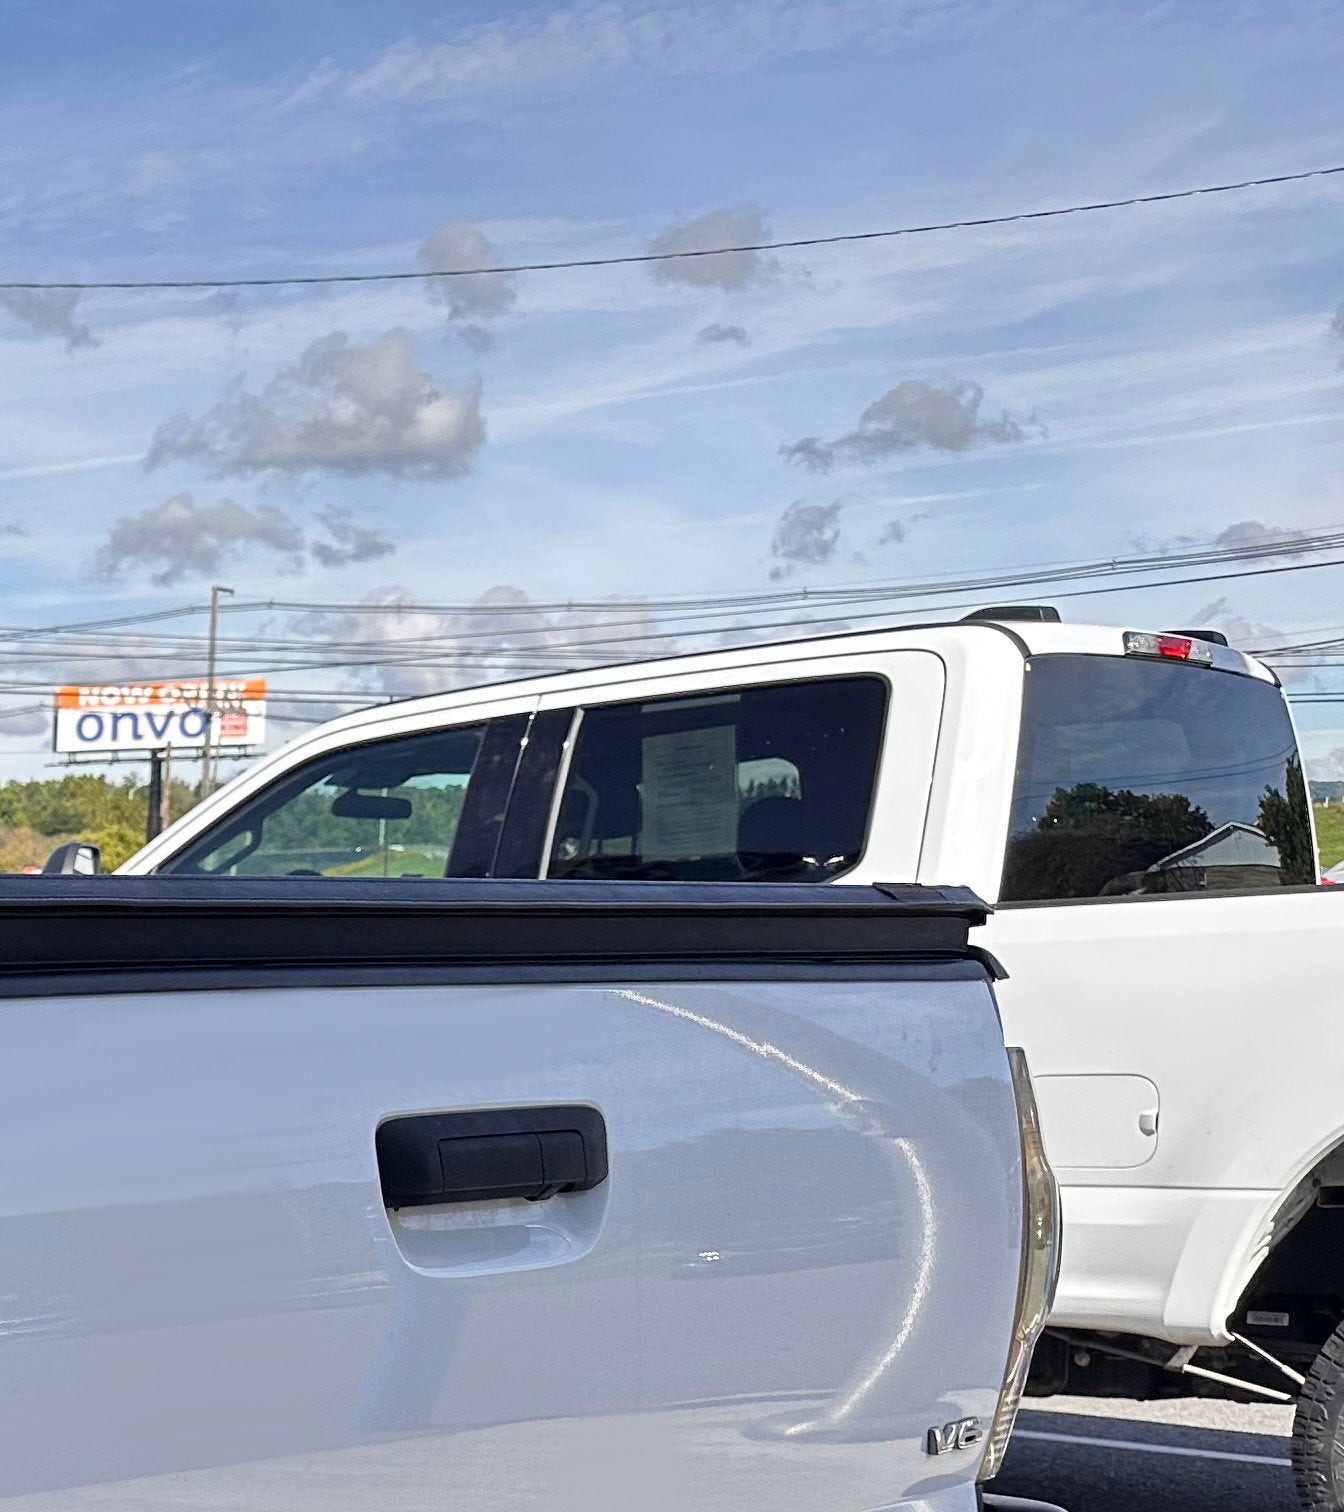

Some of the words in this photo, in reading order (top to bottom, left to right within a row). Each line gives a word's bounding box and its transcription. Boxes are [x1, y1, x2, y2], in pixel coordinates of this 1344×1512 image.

[79, 686, 153, 707] NOW
[76, 708, 209, 741] onvo
[927, 1416, 983, 1455] V6
